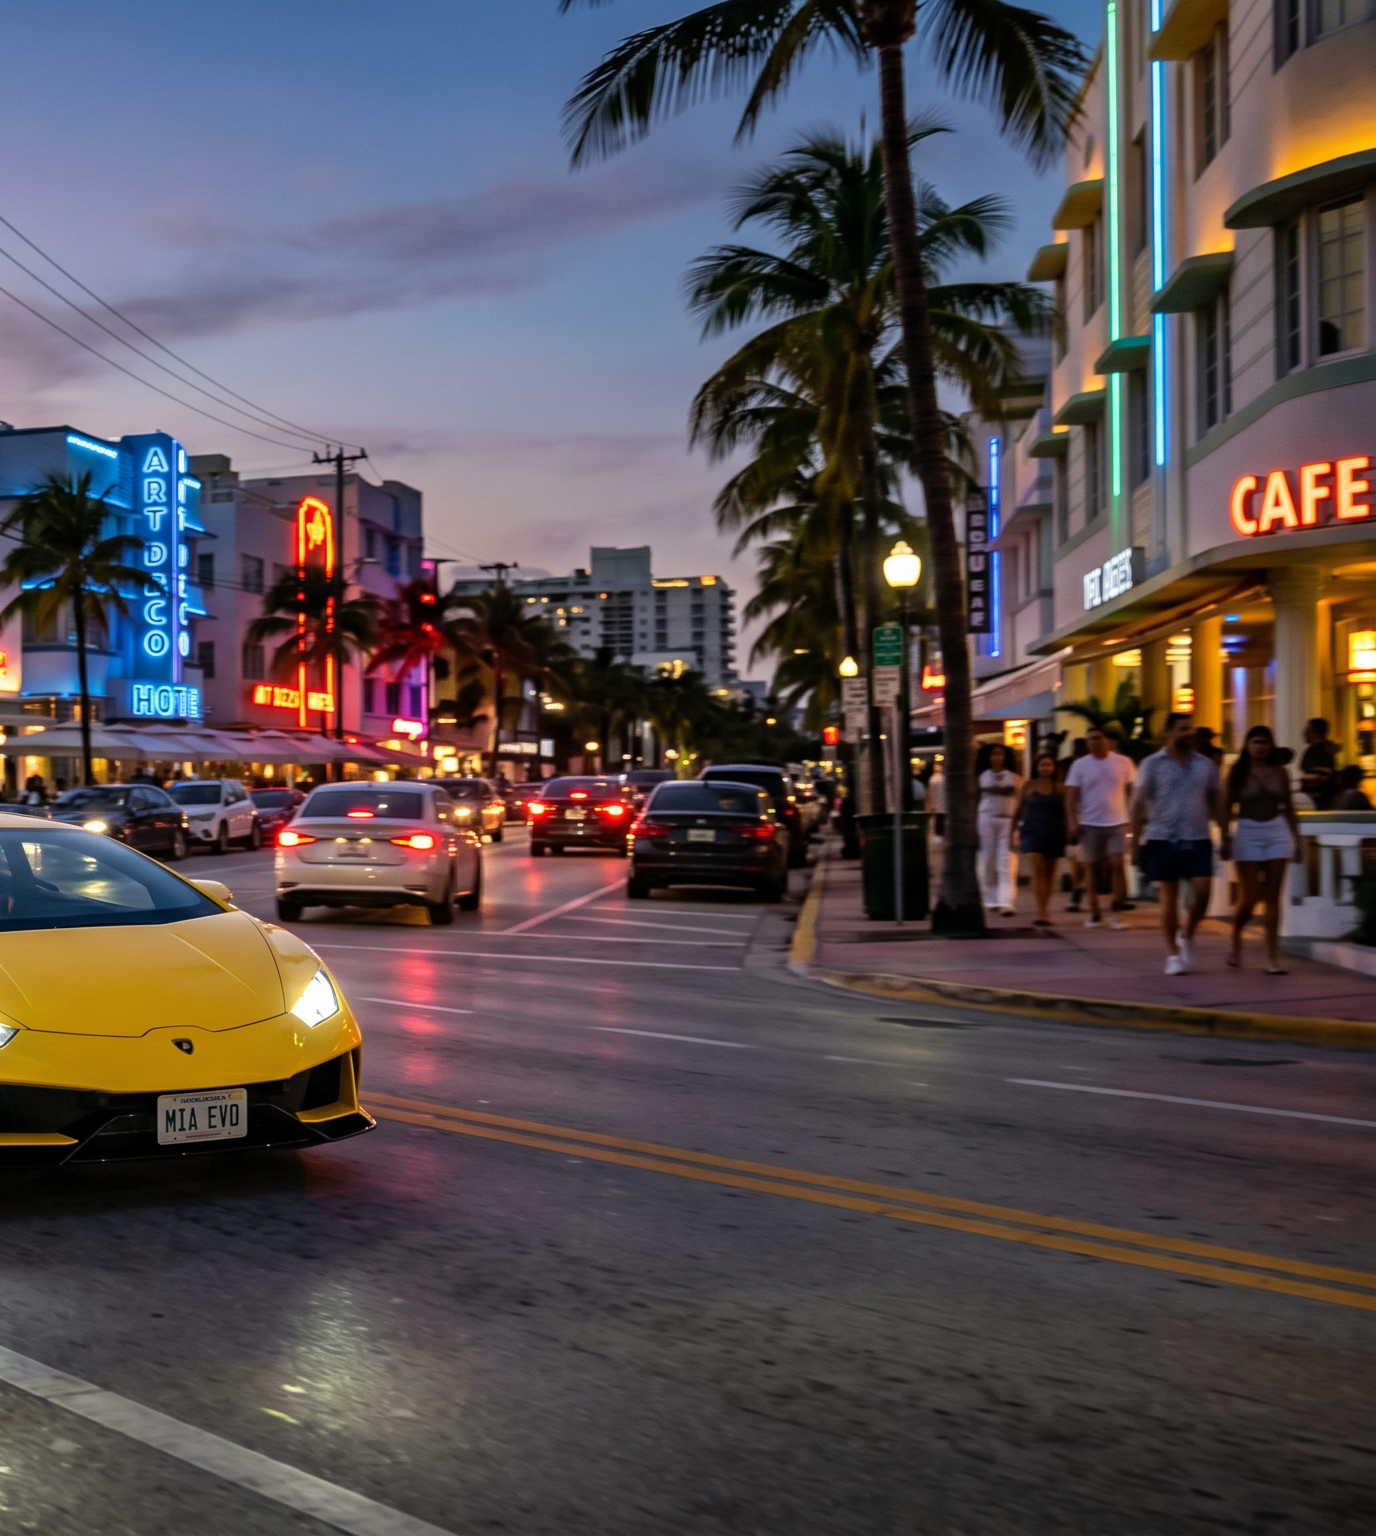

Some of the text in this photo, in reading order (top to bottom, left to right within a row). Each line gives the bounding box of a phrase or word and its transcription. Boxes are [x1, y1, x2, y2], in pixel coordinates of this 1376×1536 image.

[143, 446, 169, 531] ART
[1230, 455, 1370, 536] CAFE
[165, 1107, 198, 1133] MIA
